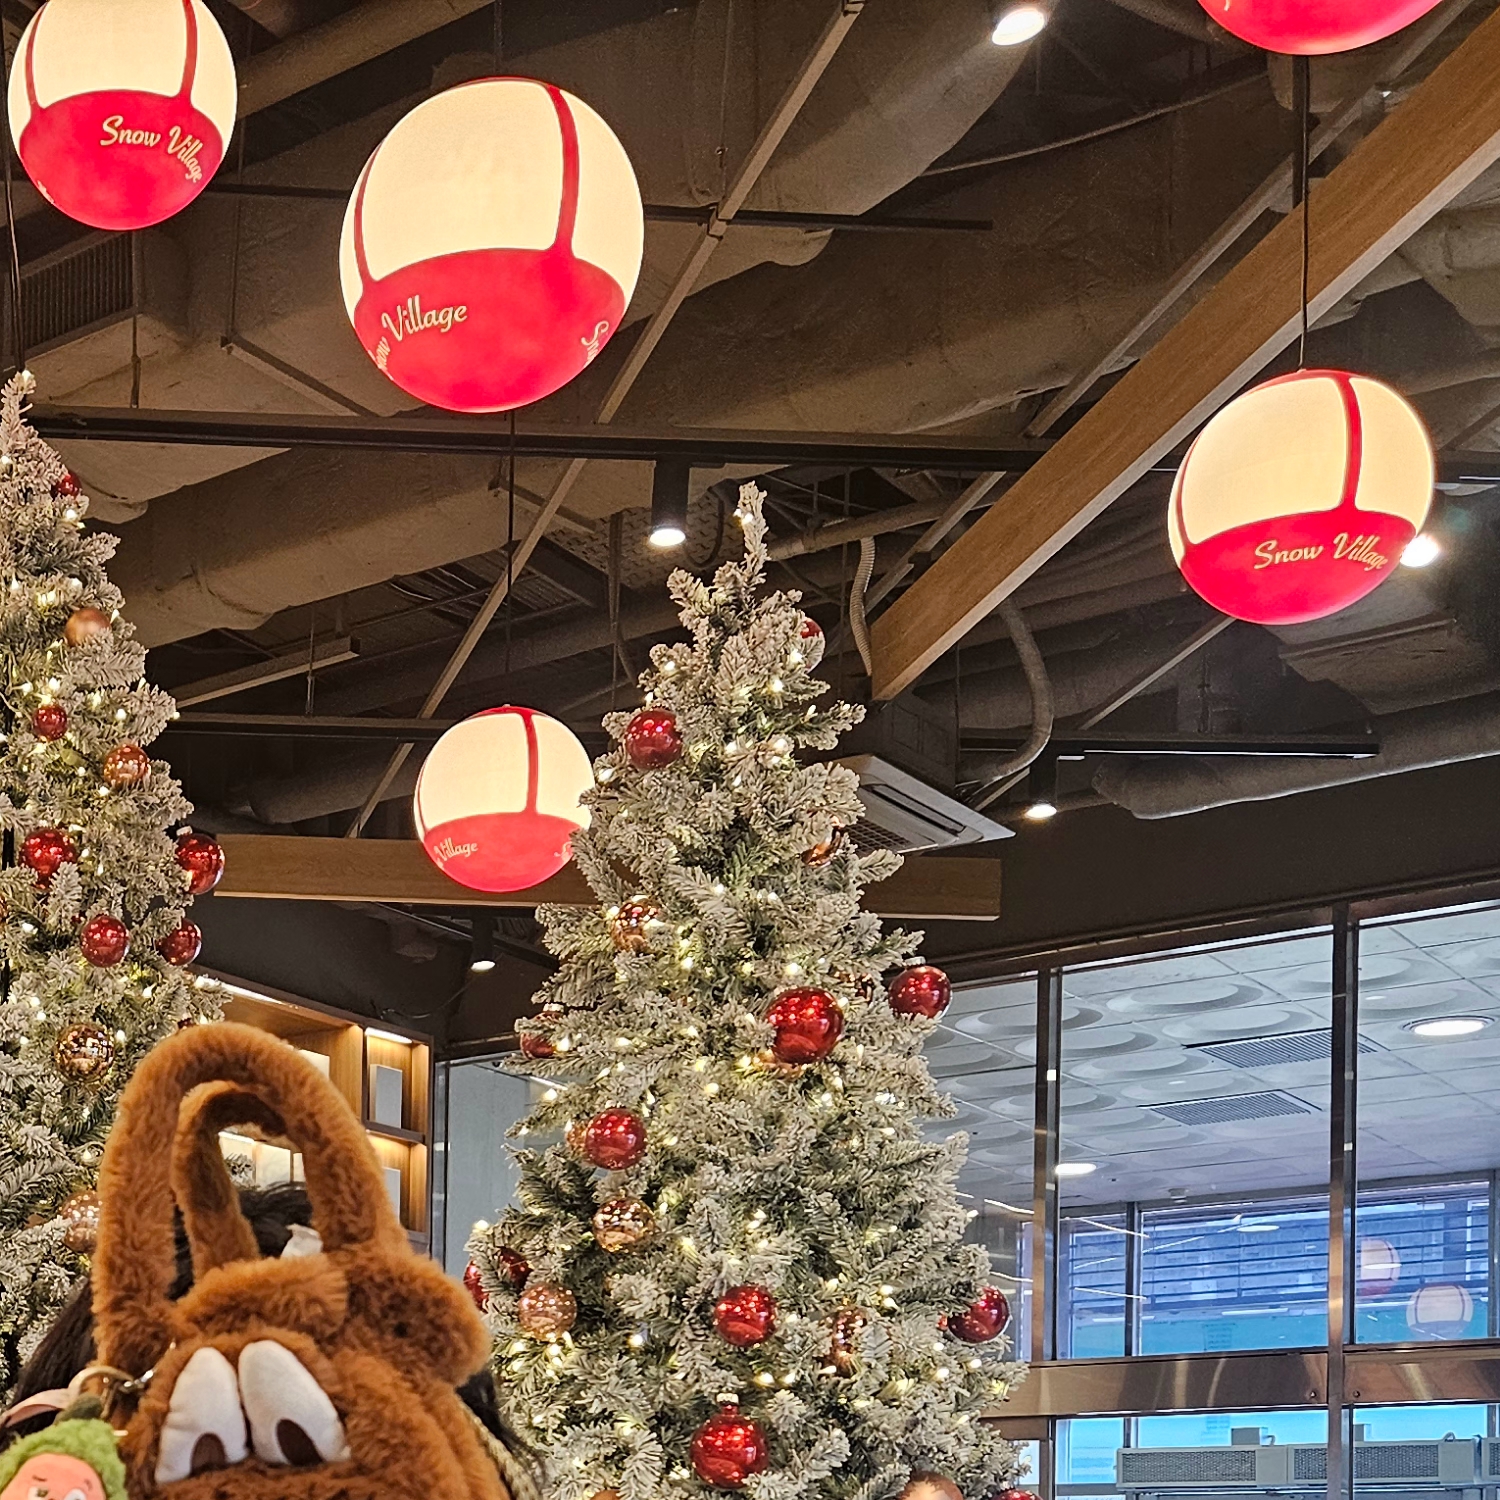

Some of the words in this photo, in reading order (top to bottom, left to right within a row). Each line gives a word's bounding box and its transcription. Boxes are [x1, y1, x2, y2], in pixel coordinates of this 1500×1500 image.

[100, 115, 161, 147] Snow
[167, 125, 204, 183] Village
[381, 295, 467, 341] Village
[1254, 540, 1323, 570] Snow
[1333, 532, 1388, 572] Village
[434, 837, 478, 861] Village
